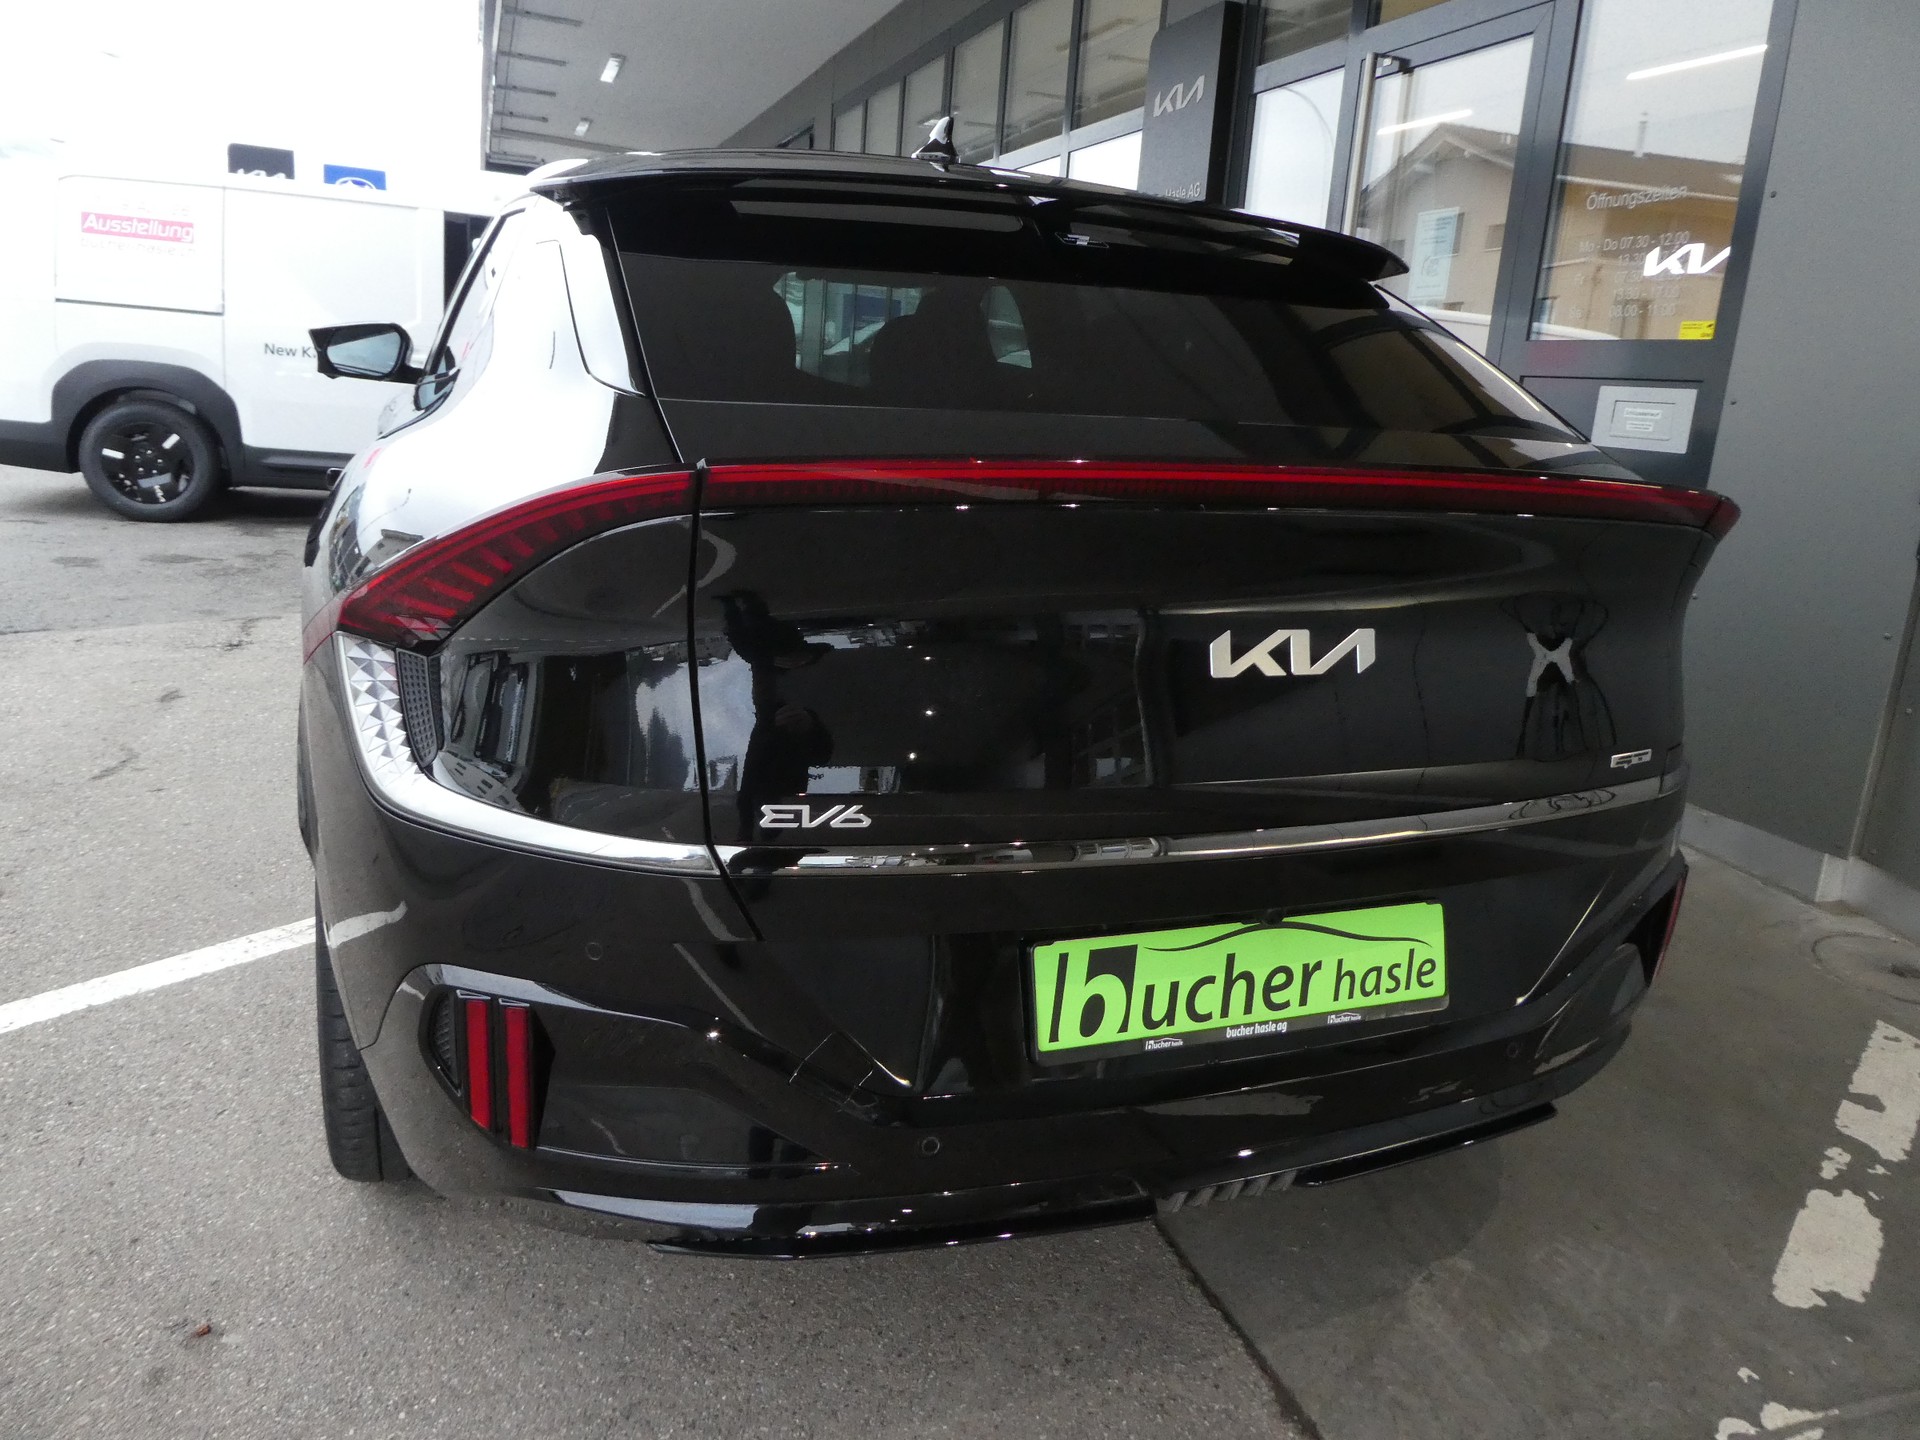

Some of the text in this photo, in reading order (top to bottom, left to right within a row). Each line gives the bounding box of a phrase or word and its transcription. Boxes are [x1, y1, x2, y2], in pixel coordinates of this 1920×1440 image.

[1153, 74, 1205, 118] KIA
[1187, 182, 1200, 198] AG
[1586, 185, 1688, 211] Öffnungszeiten
[83, 213, 193, 242] Ausstellung
[1603, 238, 1618, 251] Do
[1619, 234, 1651, 250] 07.30
[264, 342, 297, 357] New
[1209, 628, 1376, 678] KIA
[759, 804, 872, 828] EV6
[1048, 944, 1437, 1043] bucher hasle
[1226, 1021, 1288, 1039] bucher hasle ag
